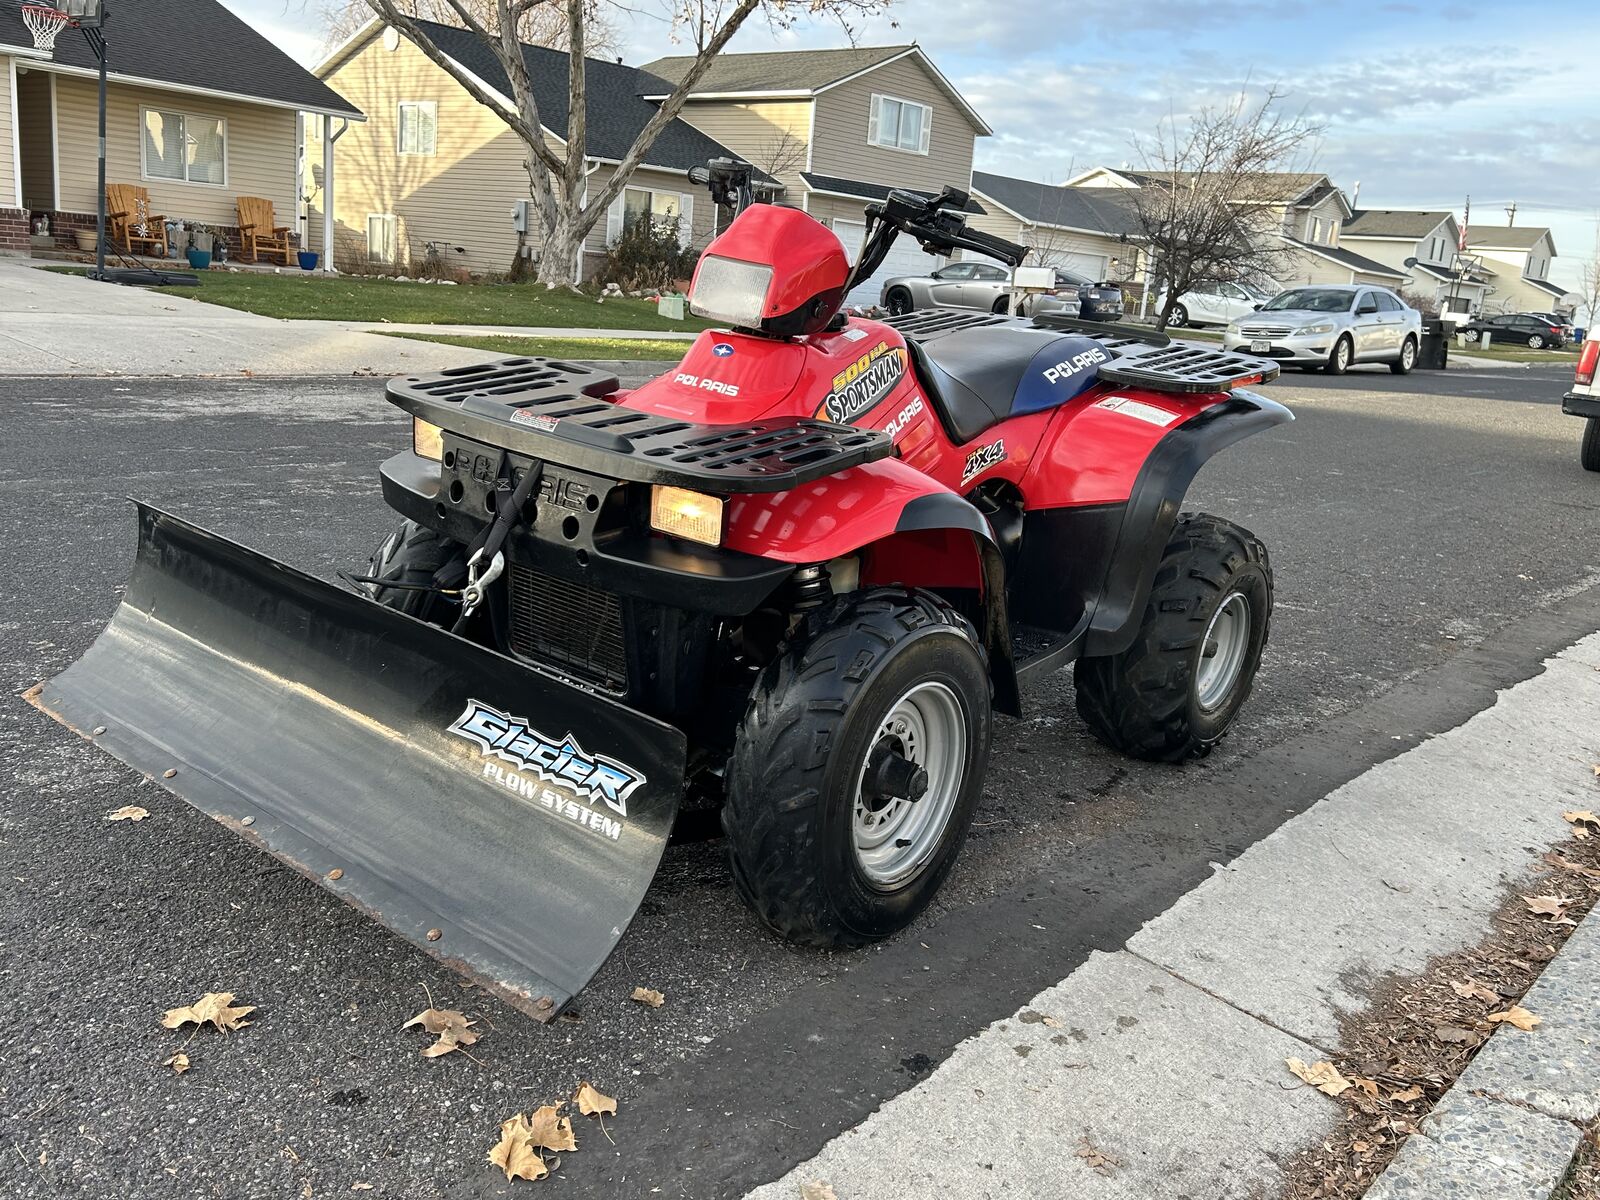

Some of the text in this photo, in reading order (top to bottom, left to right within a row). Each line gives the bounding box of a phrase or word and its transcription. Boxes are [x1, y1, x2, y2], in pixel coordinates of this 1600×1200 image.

[673, 373, 740, 397] POLARIS
[826, 348, 902, 425] SPORTSMAN
[832, 353, 871, 394] 500
[1042, 347, 1107, 385] POLARIS
[881, 395, 924, 438] OLARIS
[482, 762, 623, 842] PLOW SYSTEM
